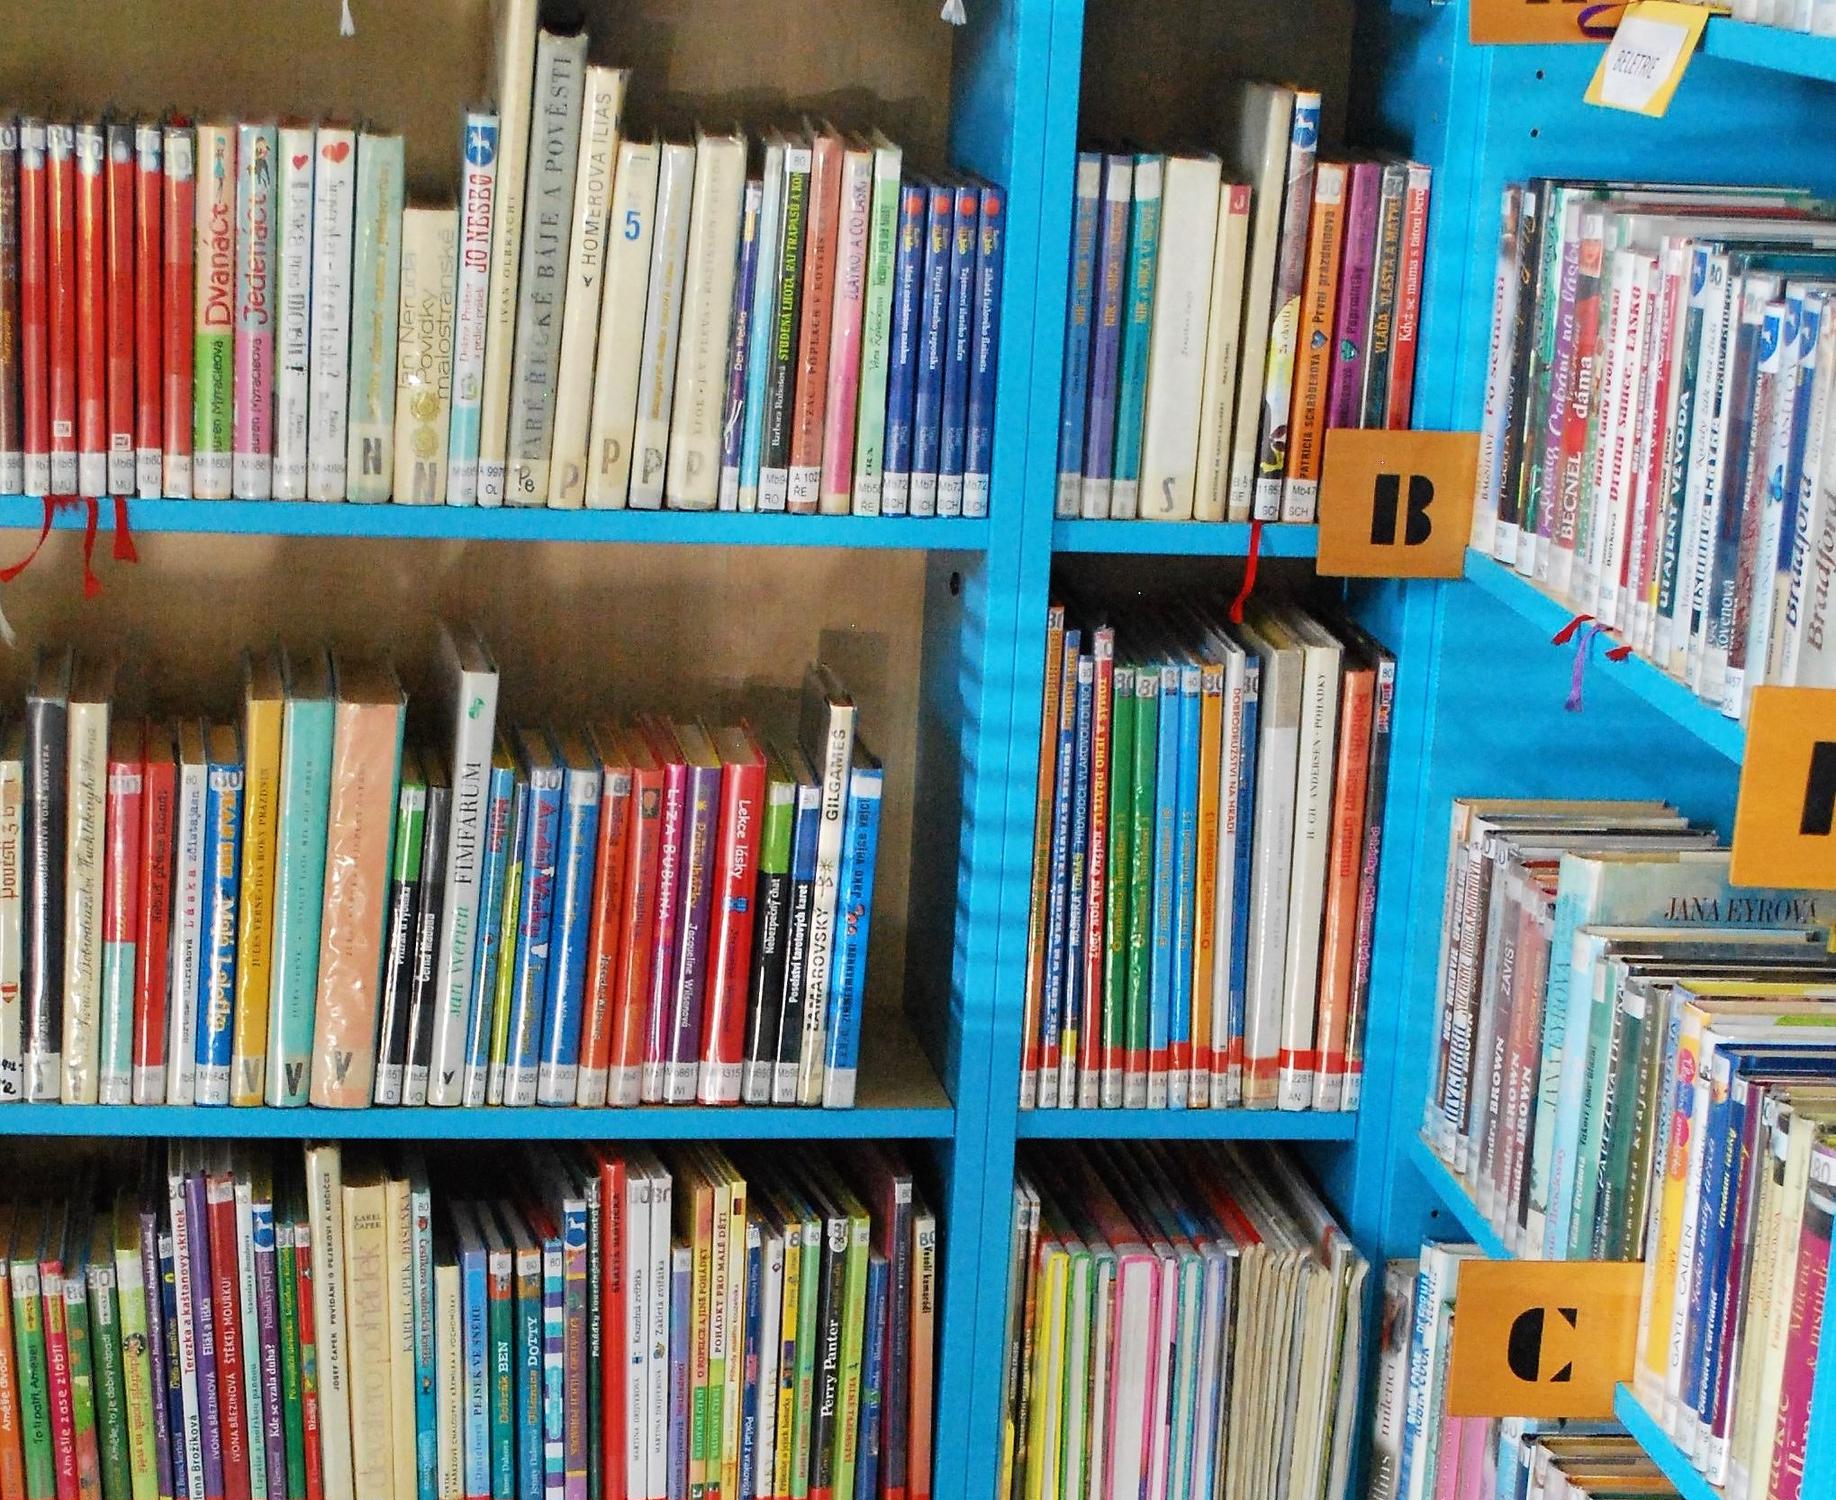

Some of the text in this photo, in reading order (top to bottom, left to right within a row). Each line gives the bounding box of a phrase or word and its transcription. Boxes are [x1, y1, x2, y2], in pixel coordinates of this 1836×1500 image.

[624, 210, 641, 241] 5
[204, 203, 231, 326] Dvanáct
[465, 248, 487, 273] JO
[1370, 473, 1435, 546] B
[498, 1341, 510, 1373] BEN
[527, 1316, 539, 1366] DOTTY
[820, 1319, 840, 1417] Perry Panter
[1506, 1307, 1578, 1383] C
